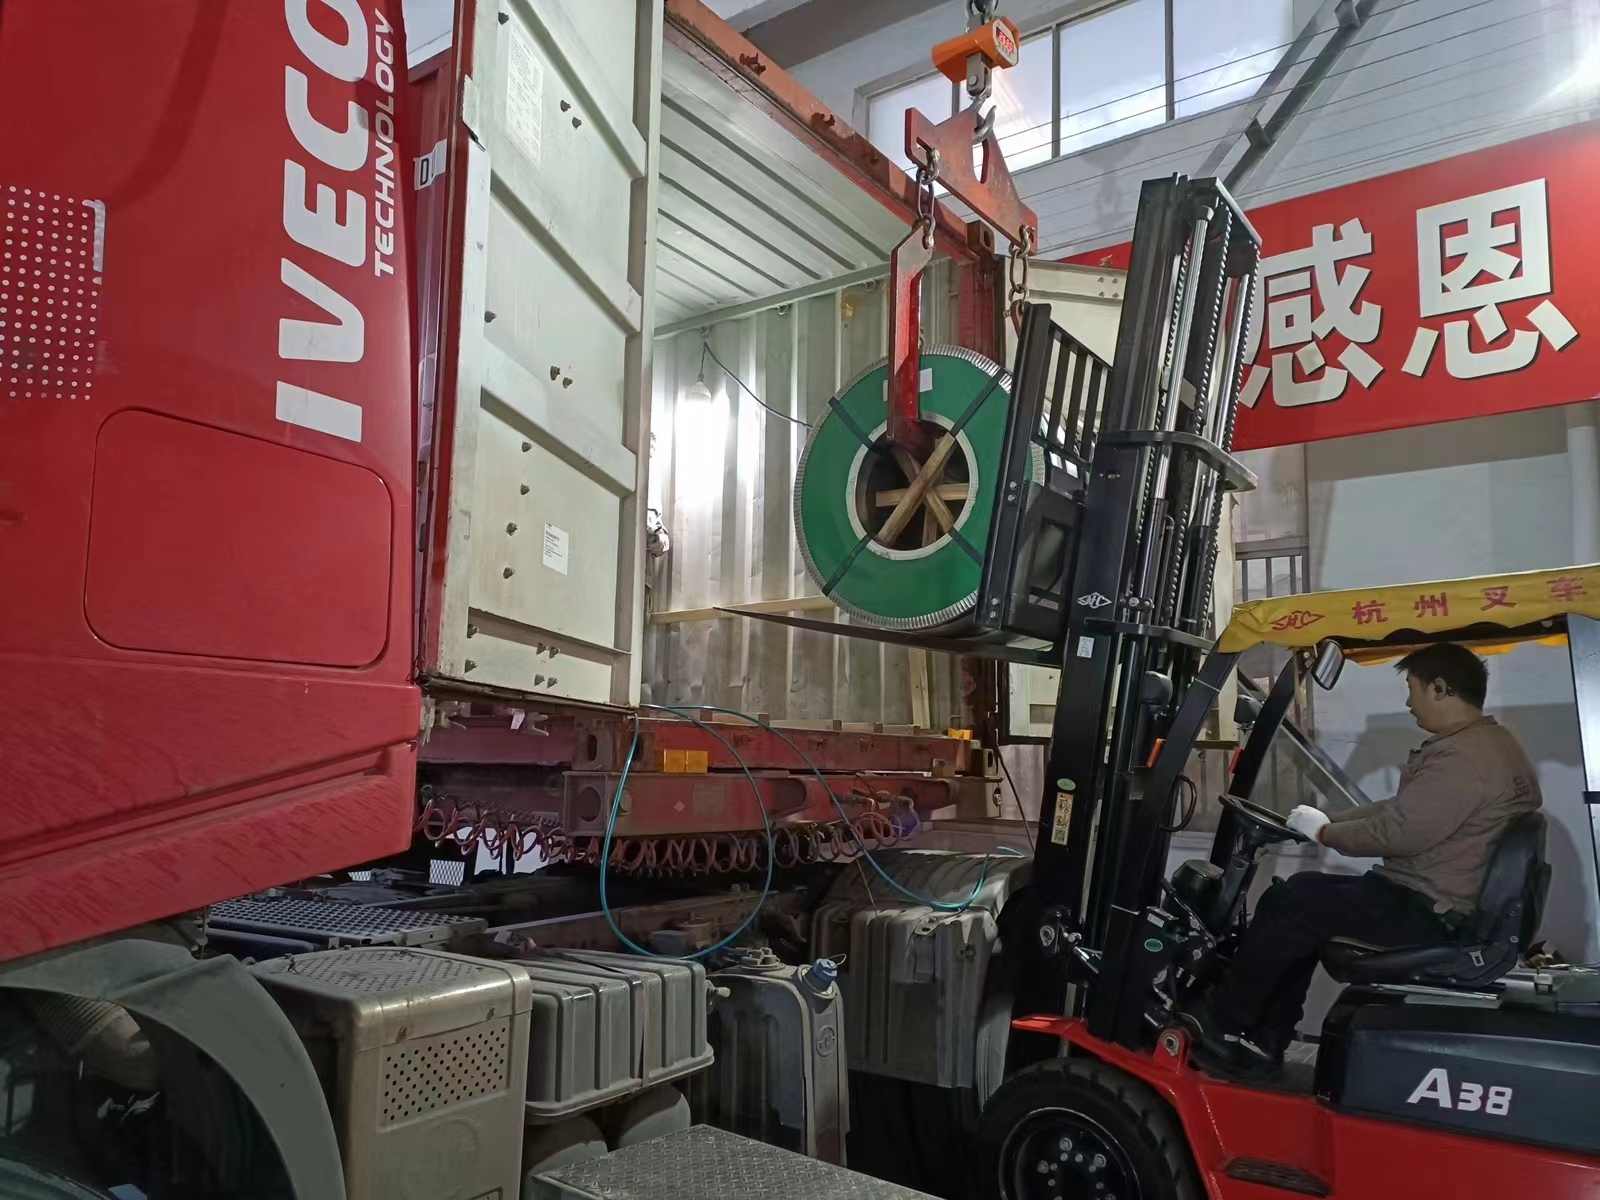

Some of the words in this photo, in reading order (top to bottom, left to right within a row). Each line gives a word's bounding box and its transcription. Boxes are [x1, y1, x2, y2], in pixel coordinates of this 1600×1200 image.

[275, 0, 369, 443] IVECO
[374, 8, 395, 278] TECHNOLOGY
[1238, 178, 1580, 408] 感恩
[1351, 576, 1587, 625] 杭州叉车
[1406, 1067, 1513, 1116] A38
